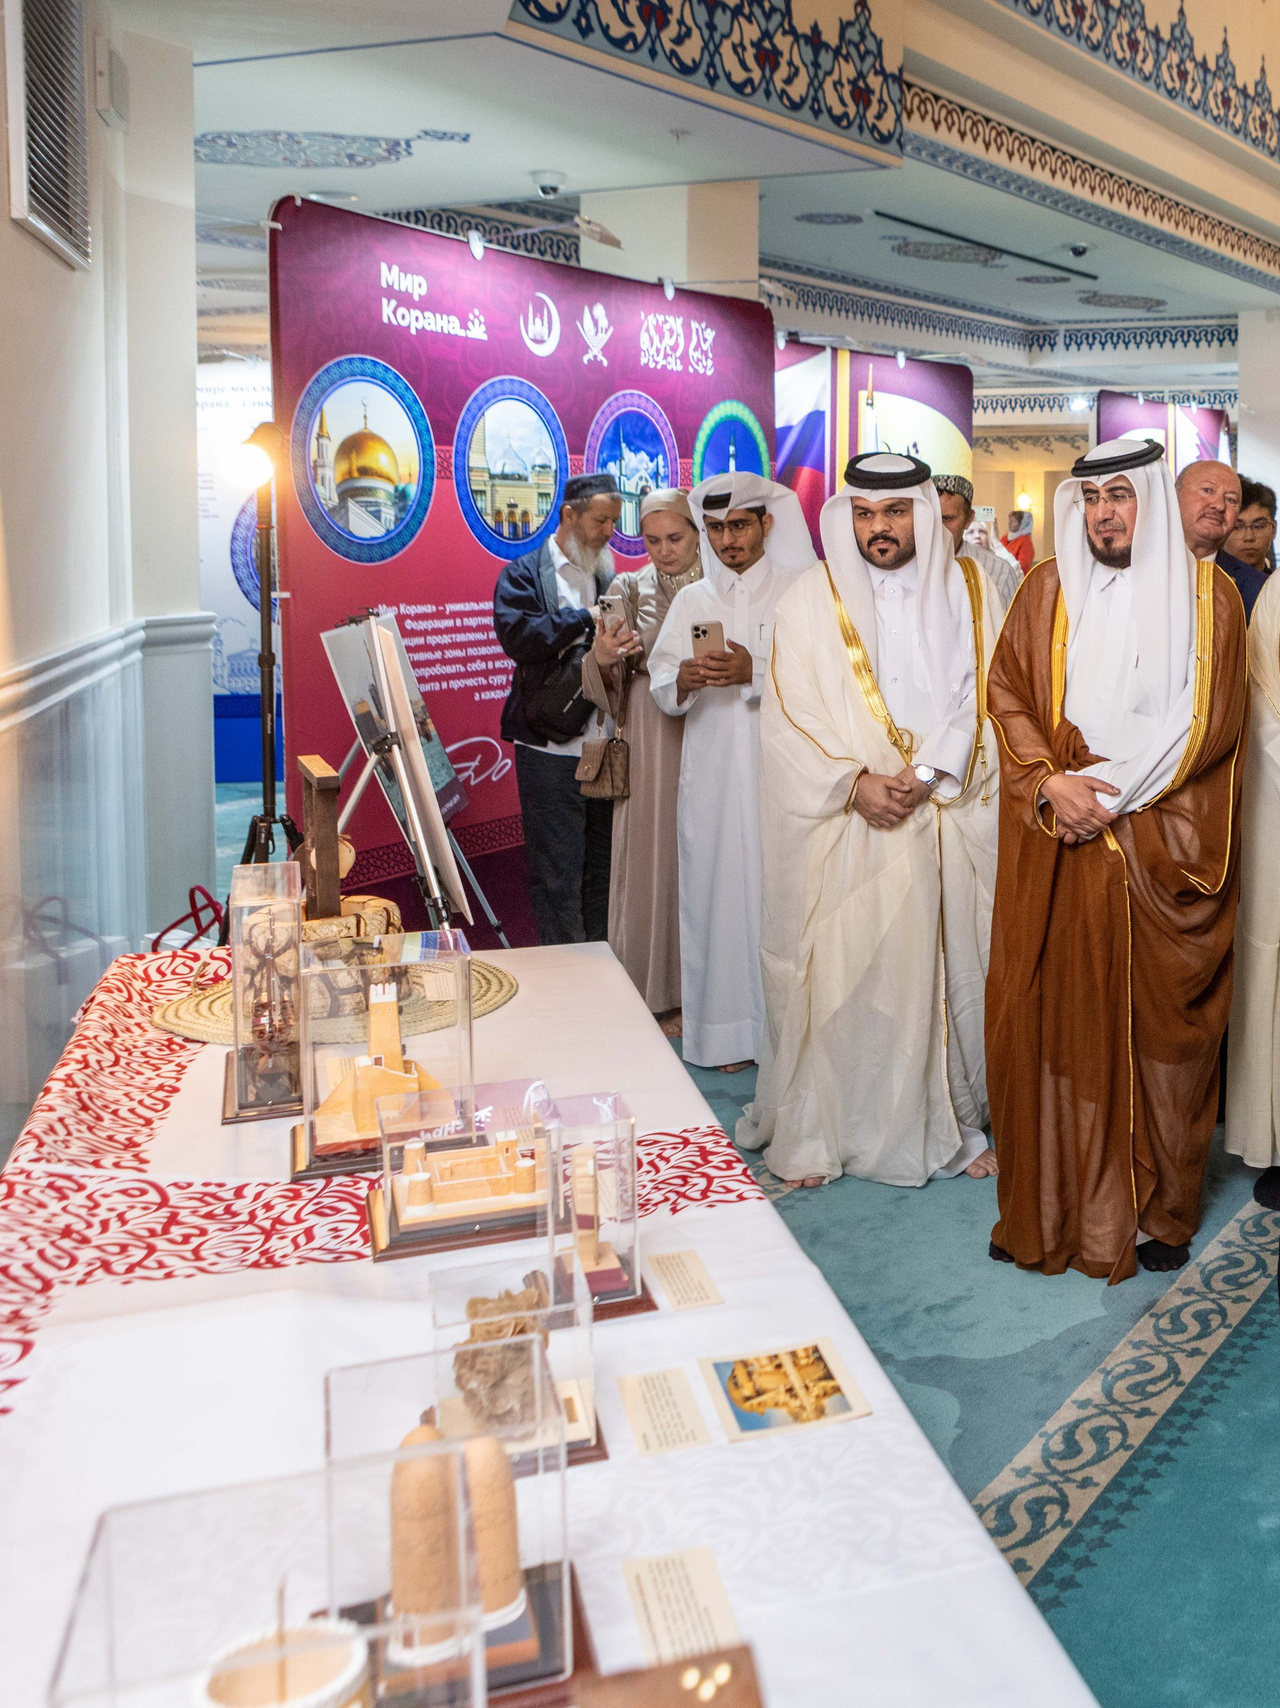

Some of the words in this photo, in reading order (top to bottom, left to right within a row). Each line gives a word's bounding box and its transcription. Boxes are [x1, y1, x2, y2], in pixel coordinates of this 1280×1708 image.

[380, 261, 428, 302] Мир
[381, 297, 467, 337] Корана
[400, 603, 437, 616] Корана»
[445, 601, 494, 614] уникальная
[404, 618, 454, 631] Федерации
[455, 618, 461, 627] в
[426, 631, 487, 646] представлены
[443, 648, 466, 658] зоны
[467, 659, 486, 671] себя
[487, 660, 493, 669] в
[441, 681, 448, 689] и
[449, 677, 487, 690] прочесть
[488, 674, 507, 686] суру
[474, 692, 480, 701] а
